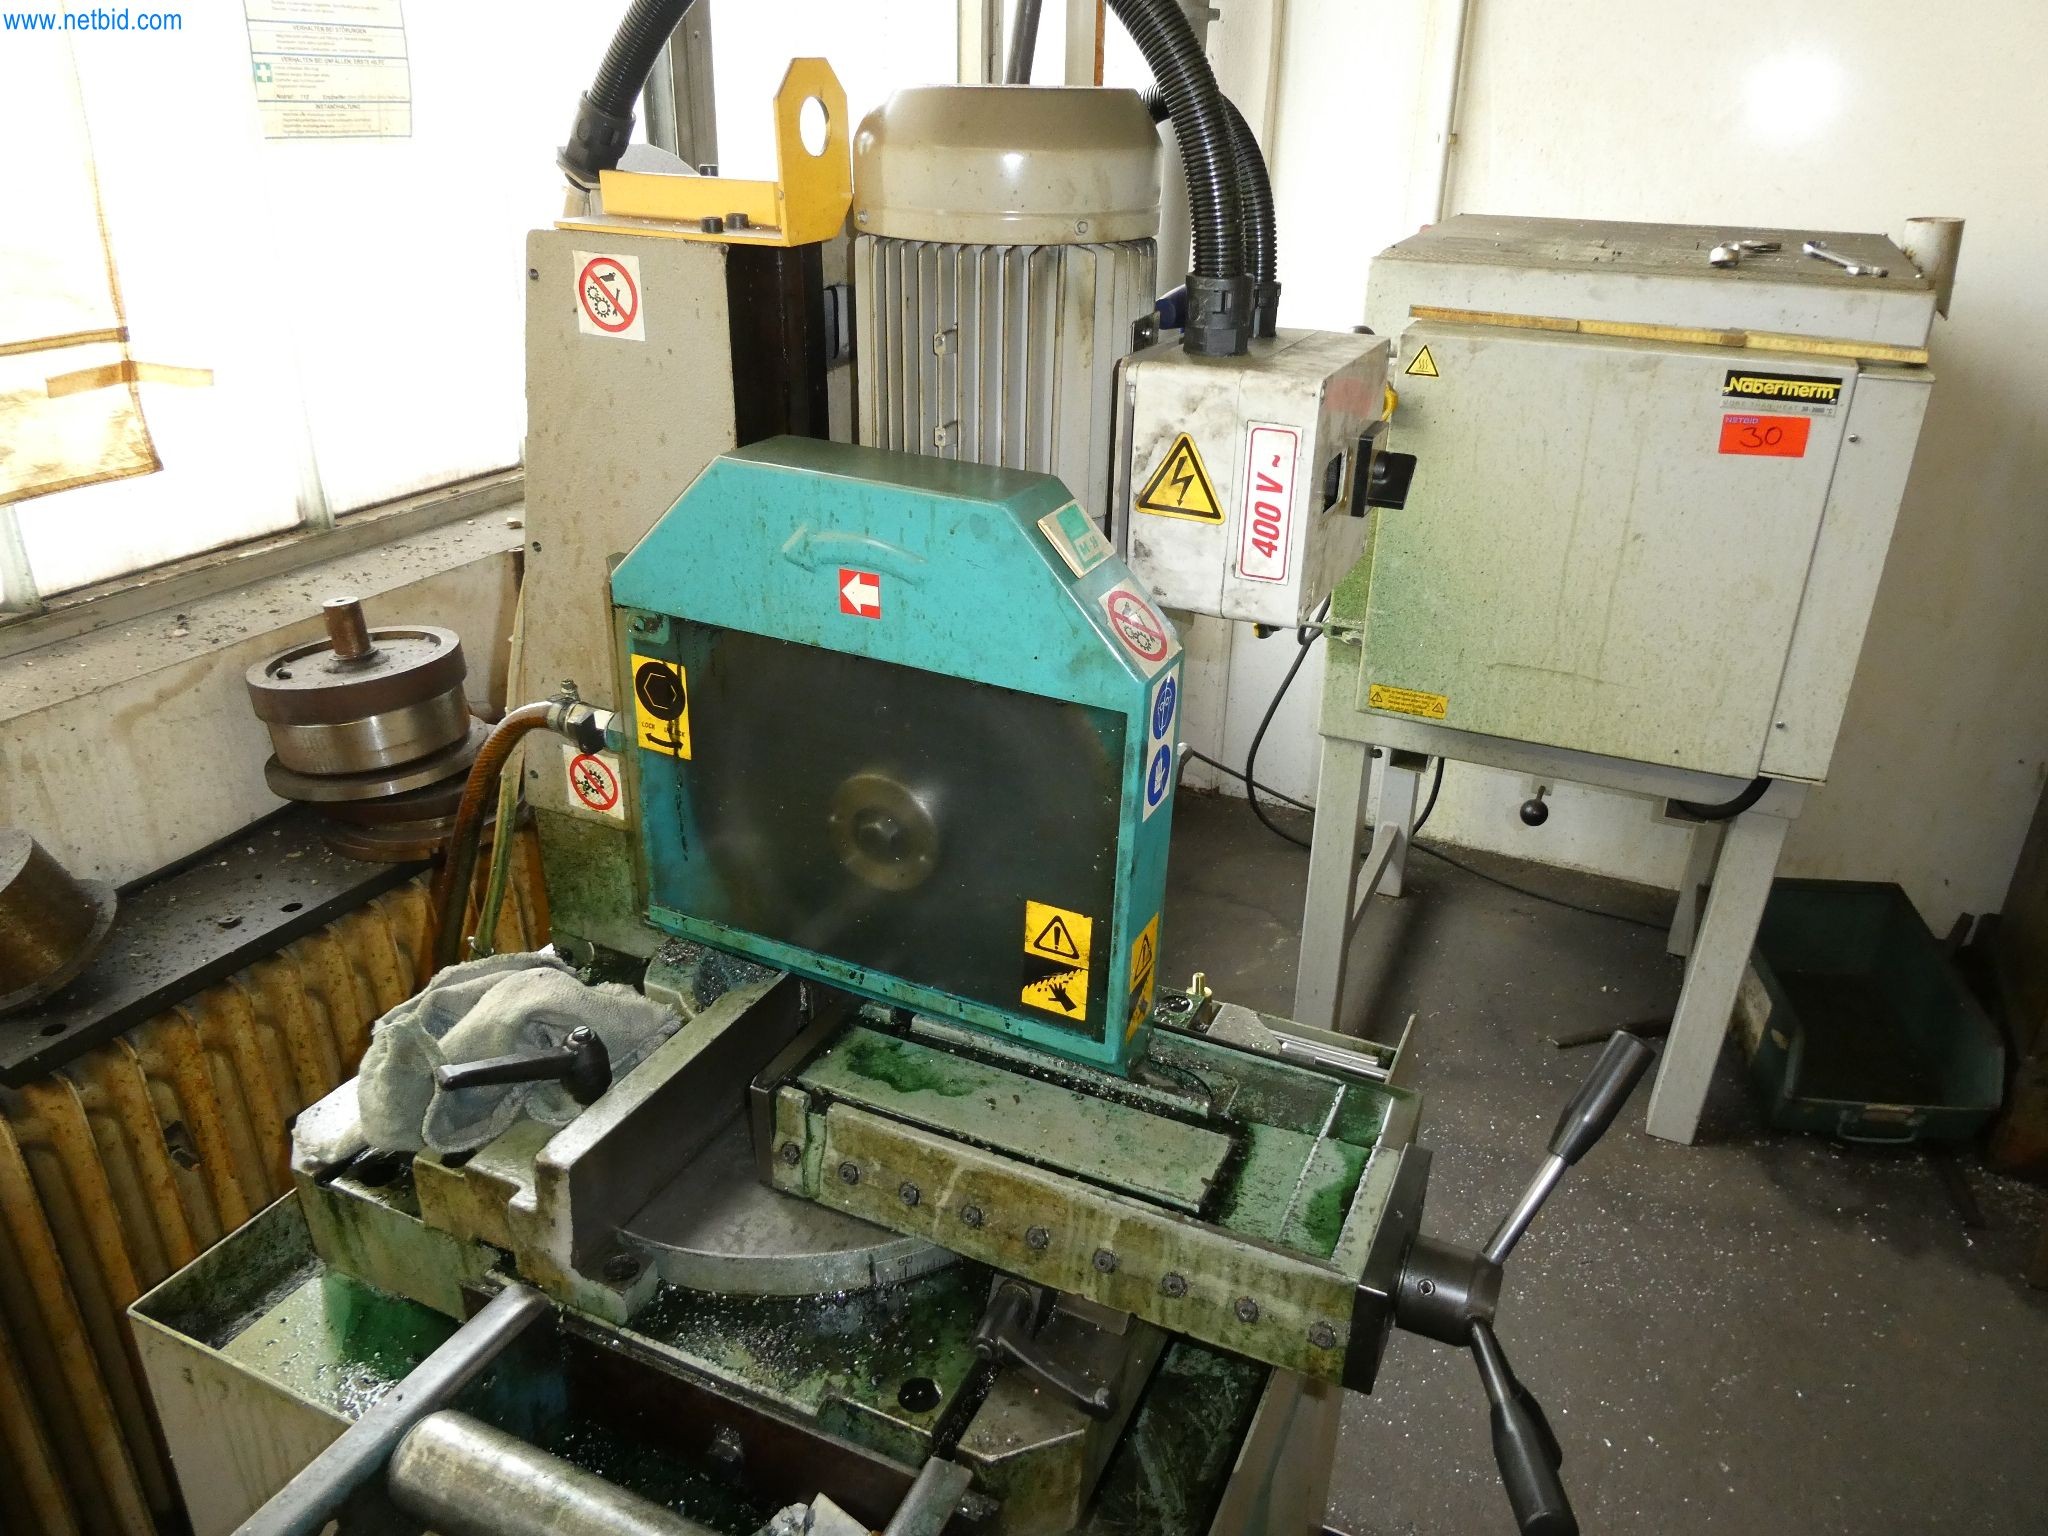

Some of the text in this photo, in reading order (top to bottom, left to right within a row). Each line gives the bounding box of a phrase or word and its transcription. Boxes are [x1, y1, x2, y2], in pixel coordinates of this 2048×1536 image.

[1725, 377, 1842, 399] Nabertherm
[1740, 427, 1782, 448] 30
[1256, 472, 1283, 493] V
[1252, 501, 1281, 558] 400
